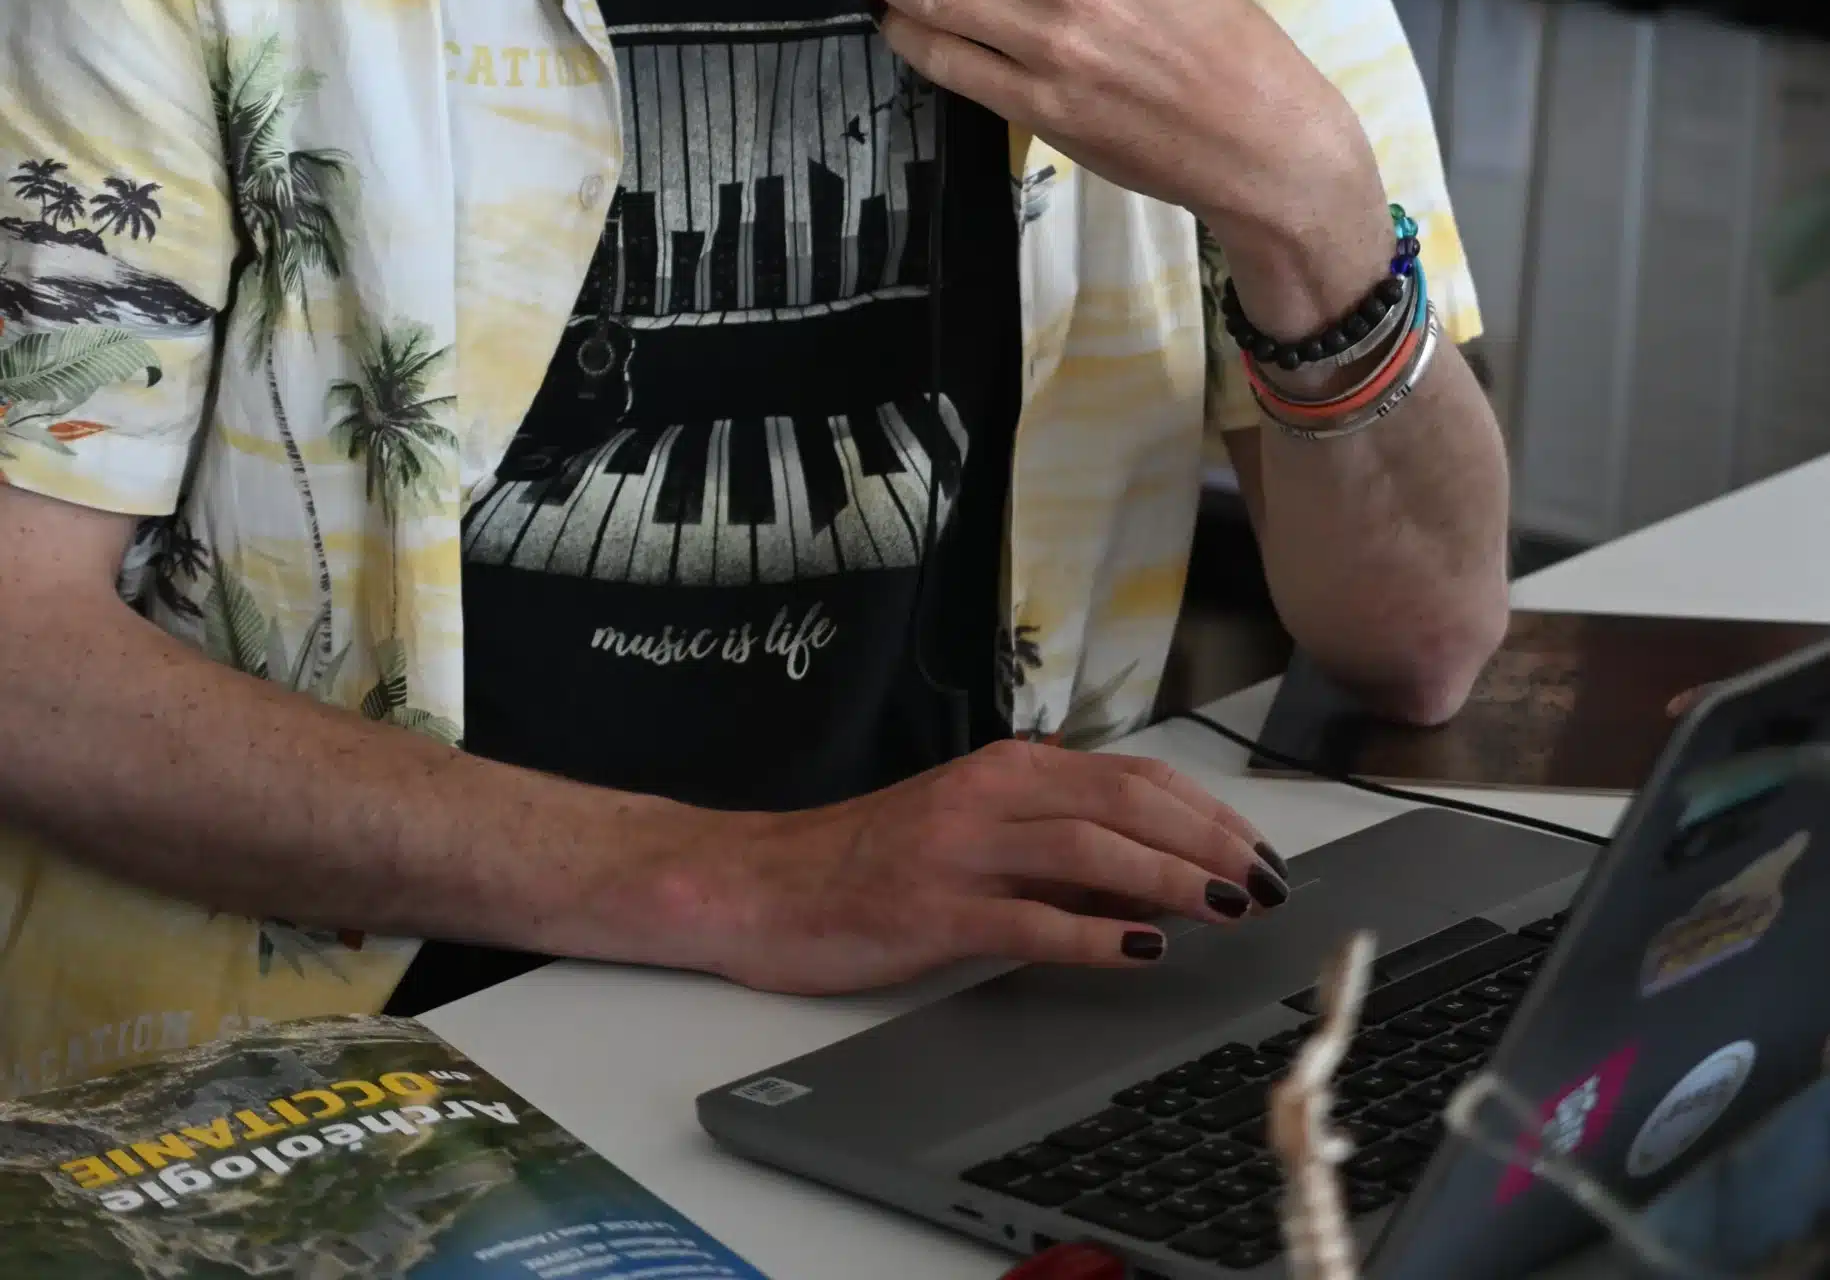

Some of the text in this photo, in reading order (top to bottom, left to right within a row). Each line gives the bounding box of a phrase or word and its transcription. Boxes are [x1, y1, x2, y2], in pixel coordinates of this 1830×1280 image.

[590, 599, 838, 681] music is life
[60, 1069, 472, 1189] en OCCITANIE
[99, 1099, 520, 1212] Archéologie
